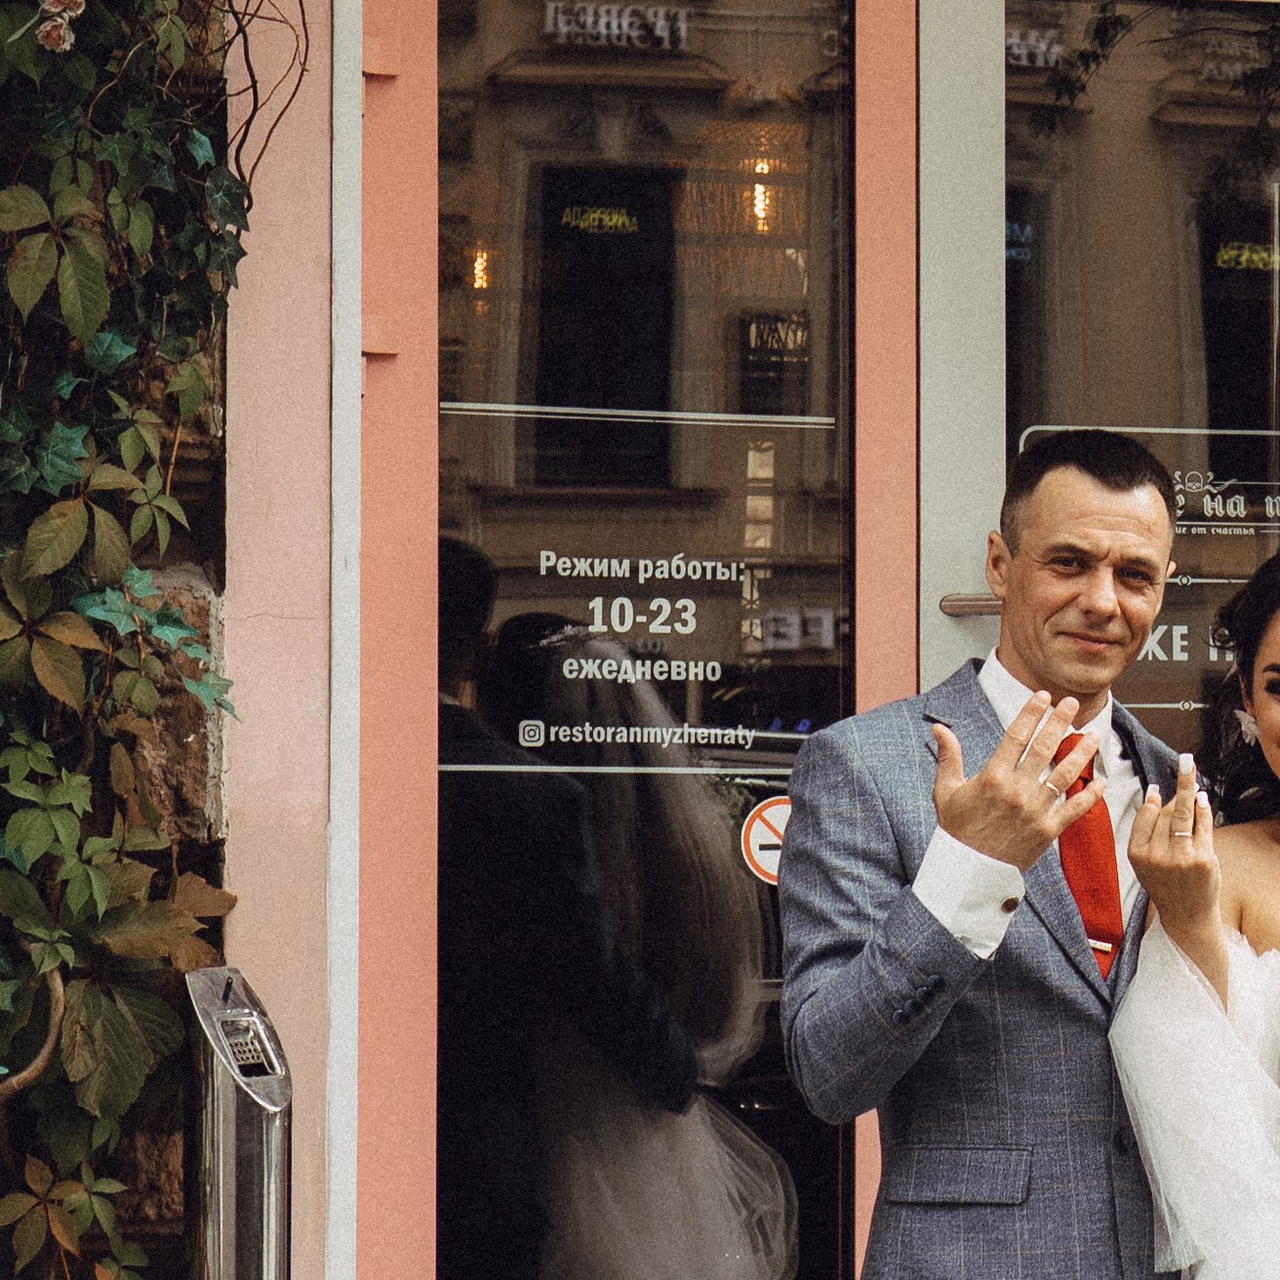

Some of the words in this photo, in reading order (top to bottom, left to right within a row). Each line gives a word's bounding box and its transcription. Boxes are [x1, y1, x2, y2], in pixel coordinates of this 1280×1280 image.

[1202, 493, 1248, 518] на
[1211, 526, 1256, 536] счастья
[539, 550, 631, 578] Режим
[638, 552, 746, 584] работы:
[587, 596, 697, 634] 10-23
[562, 657, 722, 684] ежедневно
[549, 721, 756, 750] restoranmyzhenaty
